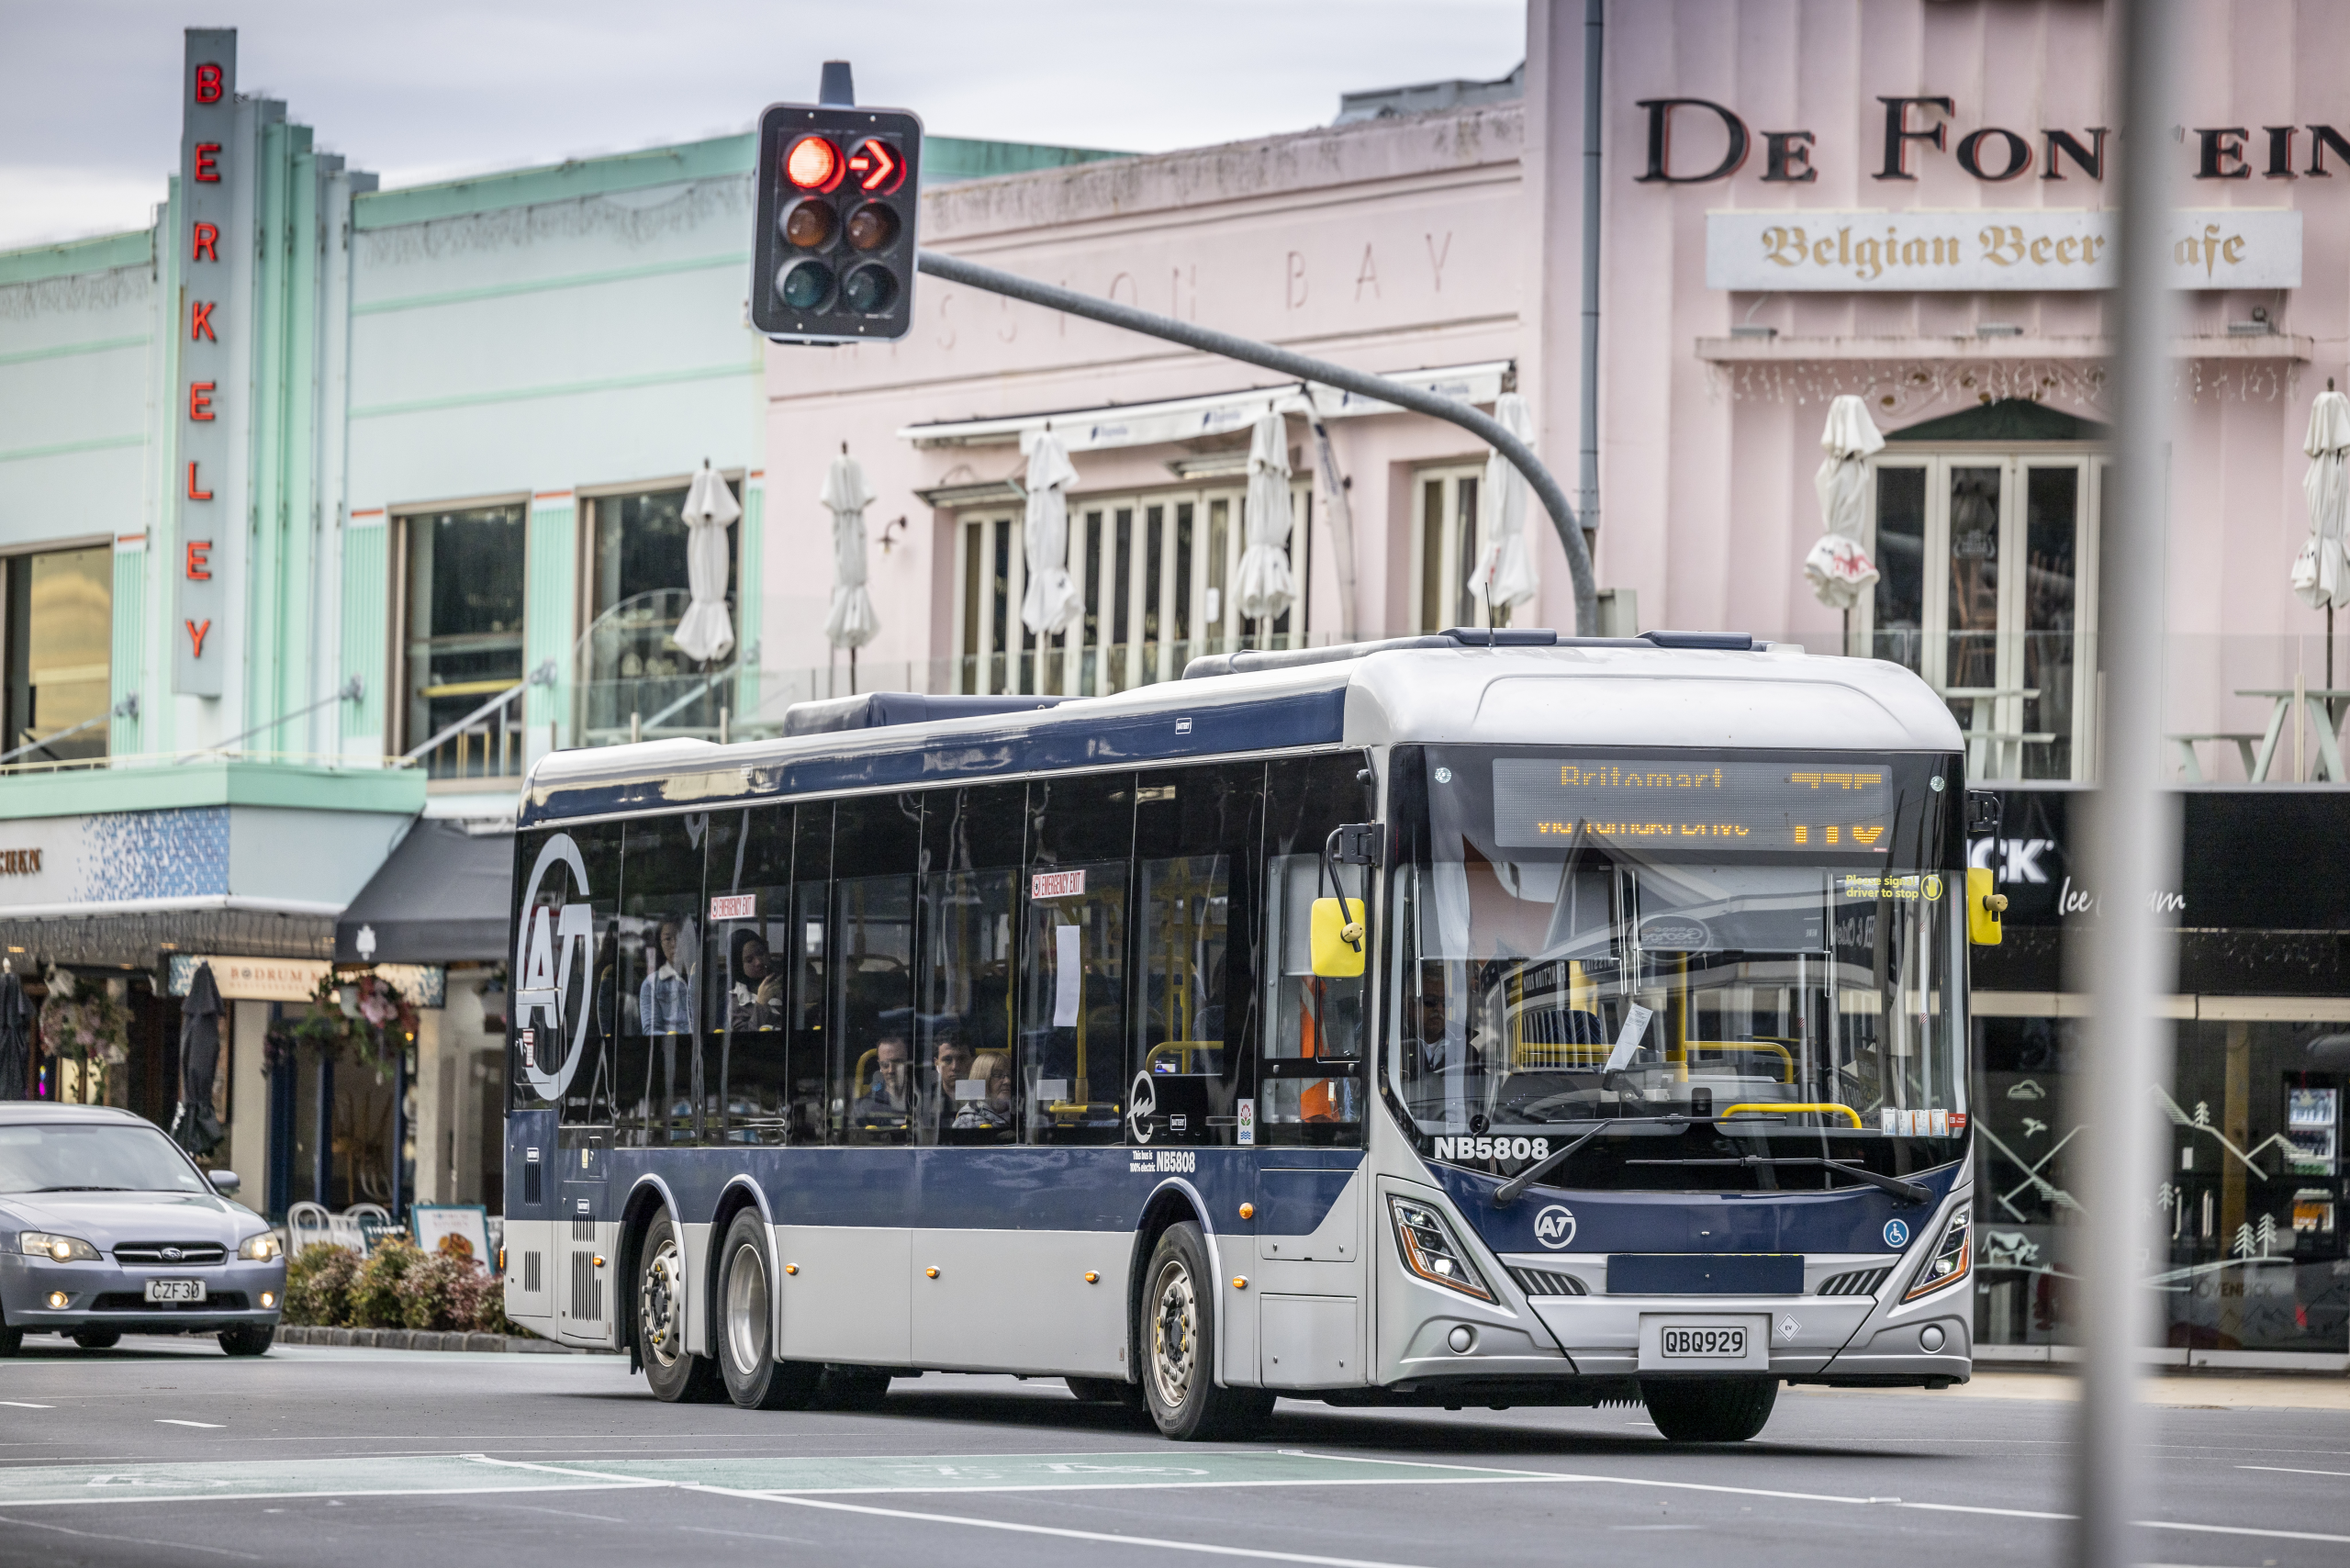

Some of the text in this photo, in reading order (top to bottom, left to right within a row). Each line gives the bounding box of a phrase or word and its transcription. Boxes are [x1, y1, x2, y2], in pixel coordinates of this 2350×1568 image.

[1633, 94, 2350, 184] DE FONEIN
[1762, 225, 1961, 279] Belgian
[1979, 225, 2106, 267] Beer
[1287, 231, 1453, 308] BAY
[185, 63, 223, 659] BERKELEY
[1041, 871, 1080, 896] EMERGENCY EXIT
[1845, 875, 1916, 890] Please signal
[1846, 887, 1919, 901] driver to stop
[2058, 876, 2093, 915] Ice
[719, 896, 752, 917] EMERGENCY EXIT
[1171, 1118, 1185, 1126] BATTERY
[1133, 1150, 1141, 1160] This
[1434, 1137, 1550, 1160] NB5808
[1130, 1161, 1156, 1172] 100% electric
[1156, 1150, 1196, 1173] NB5808
[151, 1282, 200, 1300] CZF30
[1665, 1331, 1743, 1353] QBQ929
